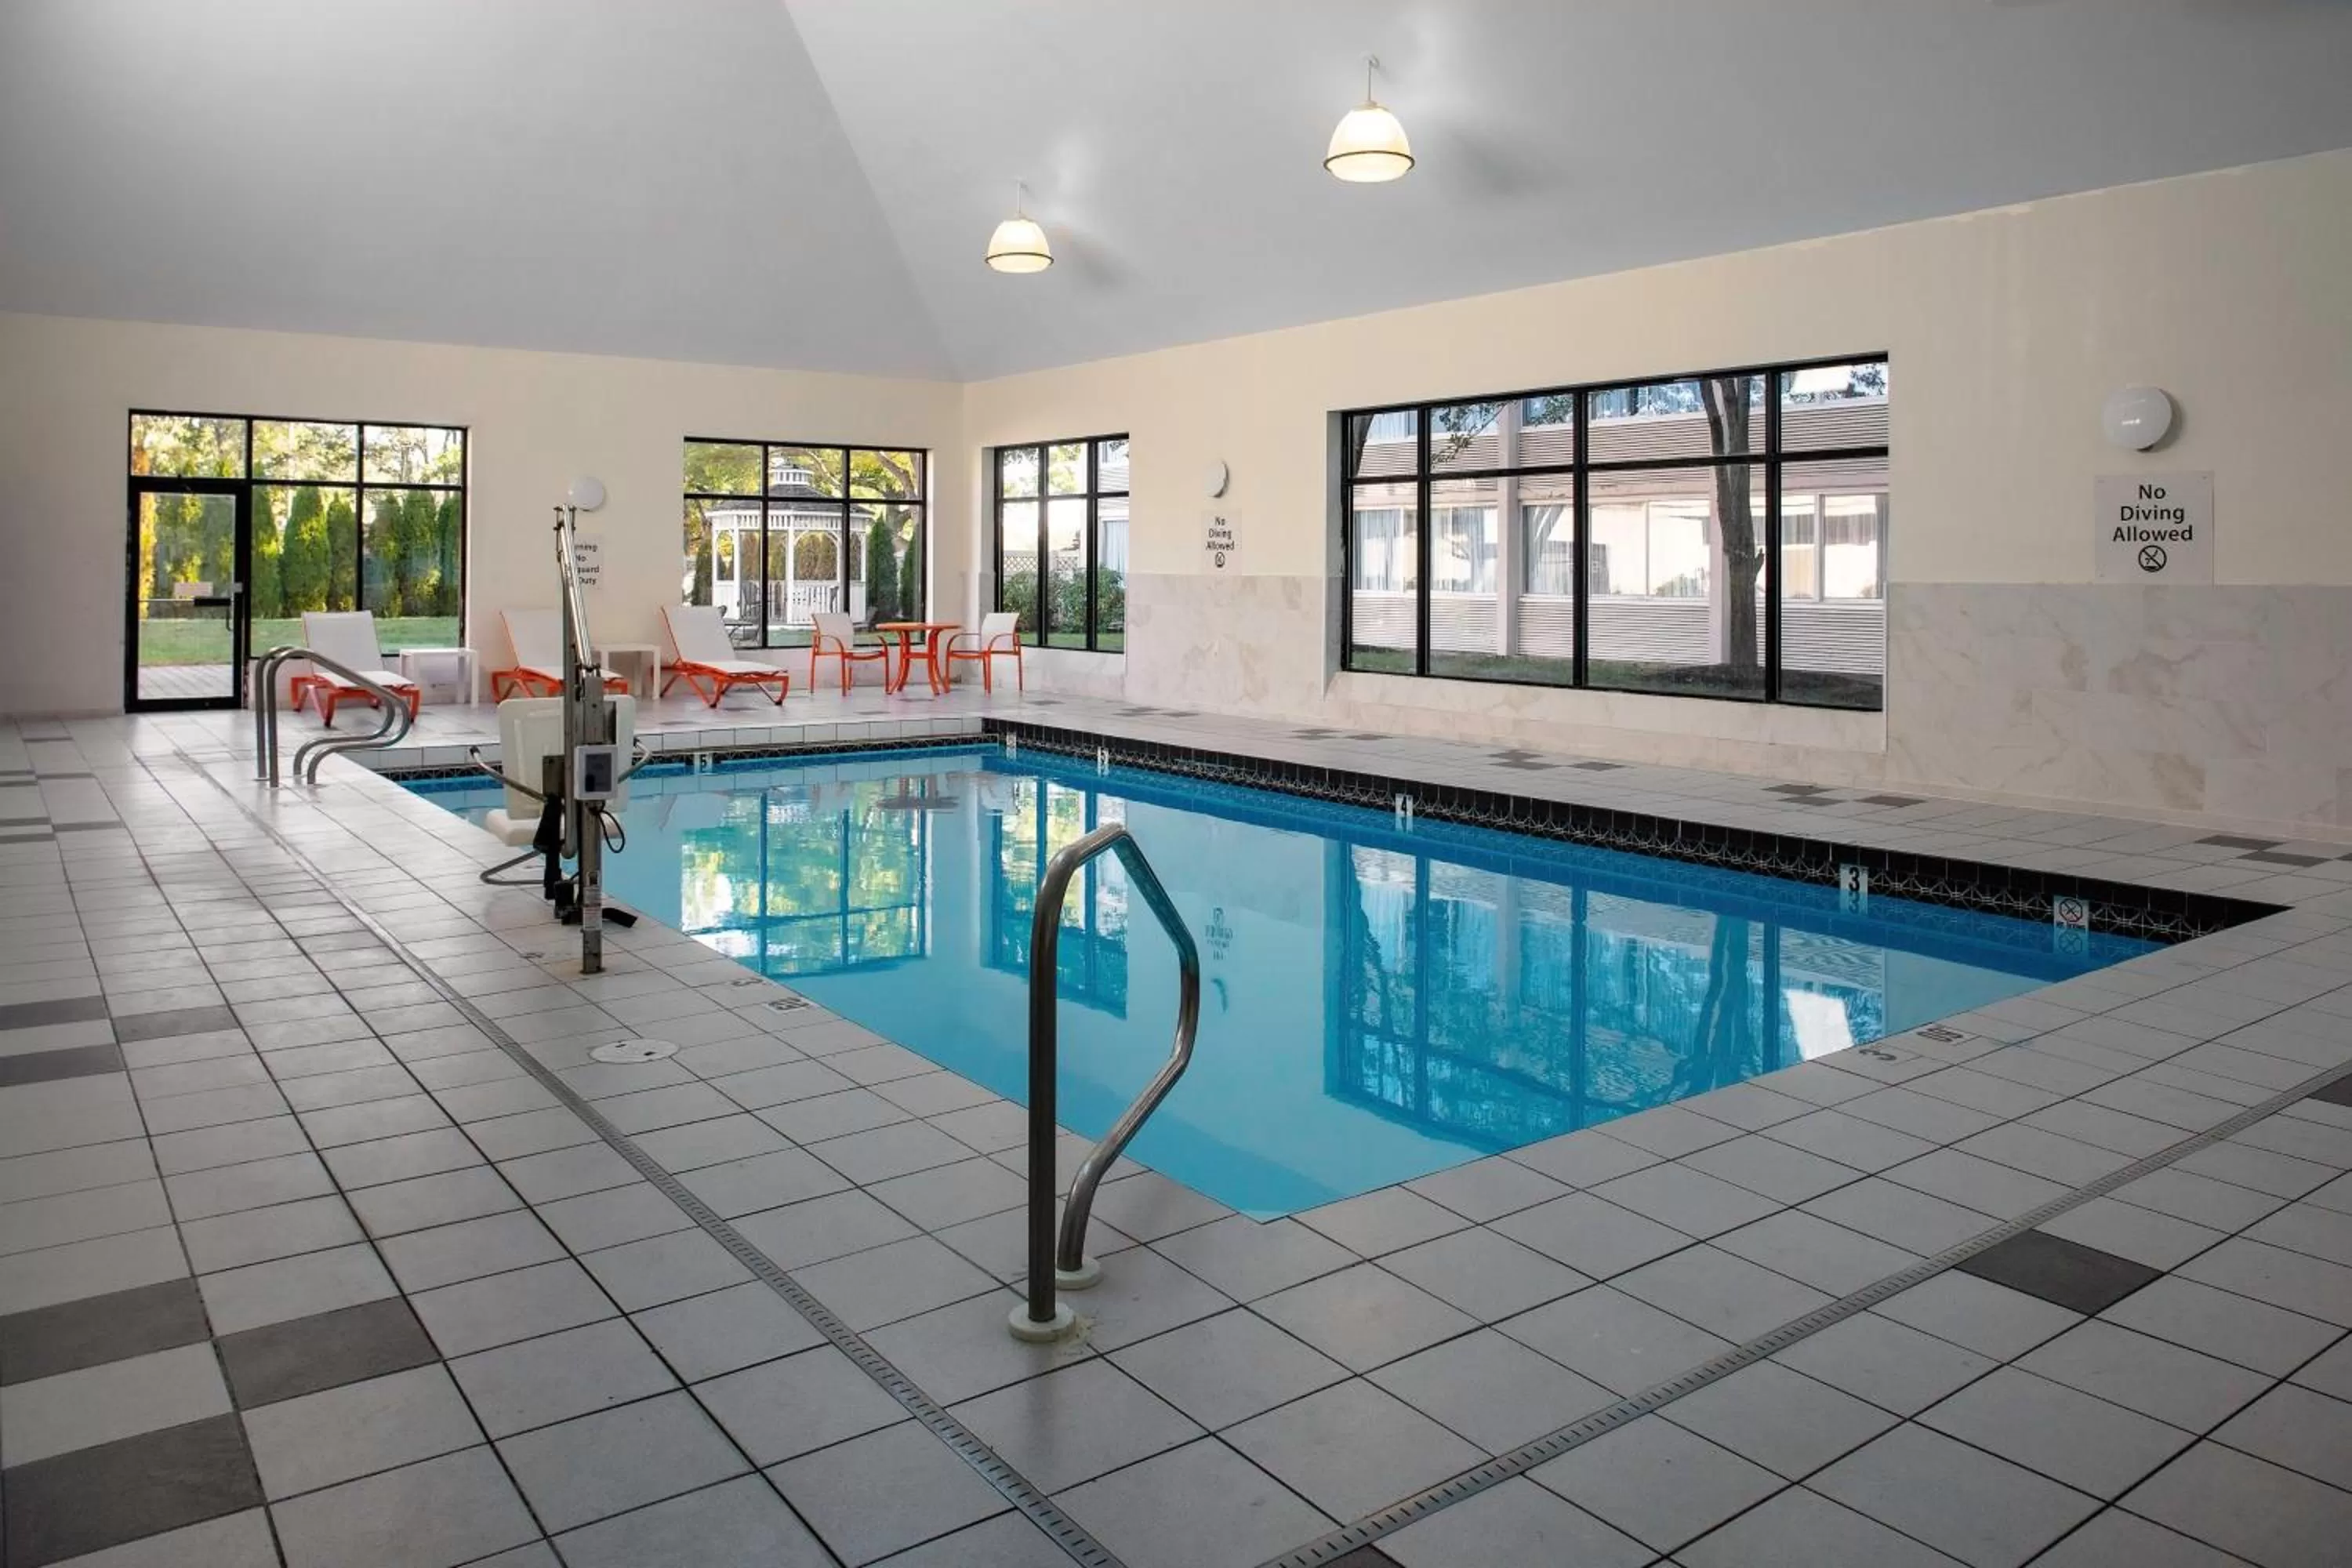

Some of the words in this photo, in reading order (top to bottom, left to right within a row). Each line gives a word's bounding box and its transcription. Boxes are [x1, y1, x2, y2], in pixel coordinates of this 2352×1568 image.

[2138, 484, 2166, 499] No
[1214, 517, 1225, 526] No
[2120, 504, 2185, 524] Diving
[2112, 524, 2194, 542] Allowed
[1206, 540, 1235, 550] Allowed
[1401, 796, 1407, 815] 4
[1849, 866, 1860, 891] 3
